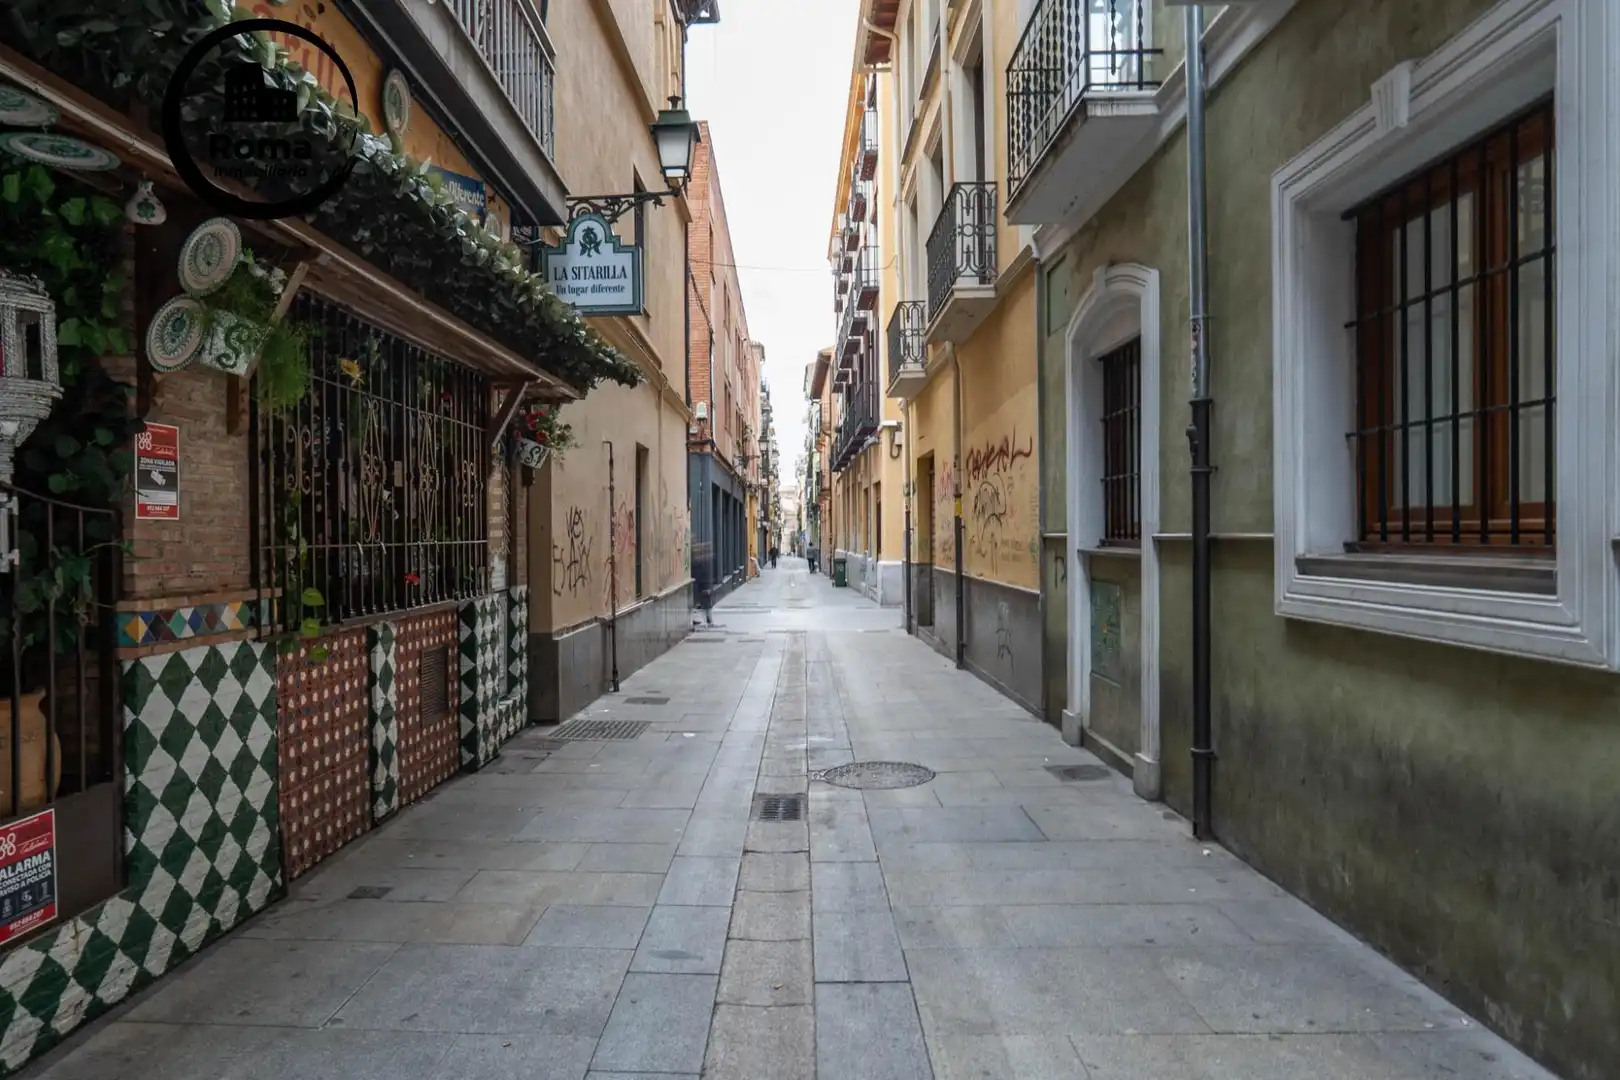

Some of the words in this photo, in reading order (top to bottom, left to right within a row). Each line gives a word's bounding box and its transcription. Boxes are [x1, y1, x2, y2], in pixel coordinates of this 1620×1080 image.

[554, 266, 568, 281] LA
[571, 264, 627, 280] SITARILLA
[556, 284, 566, 294] Un
[568, 284, 589, 296] lugar
[590, 283, 626, 294] diferente
[0, 850, 51, 881] ALARMA
